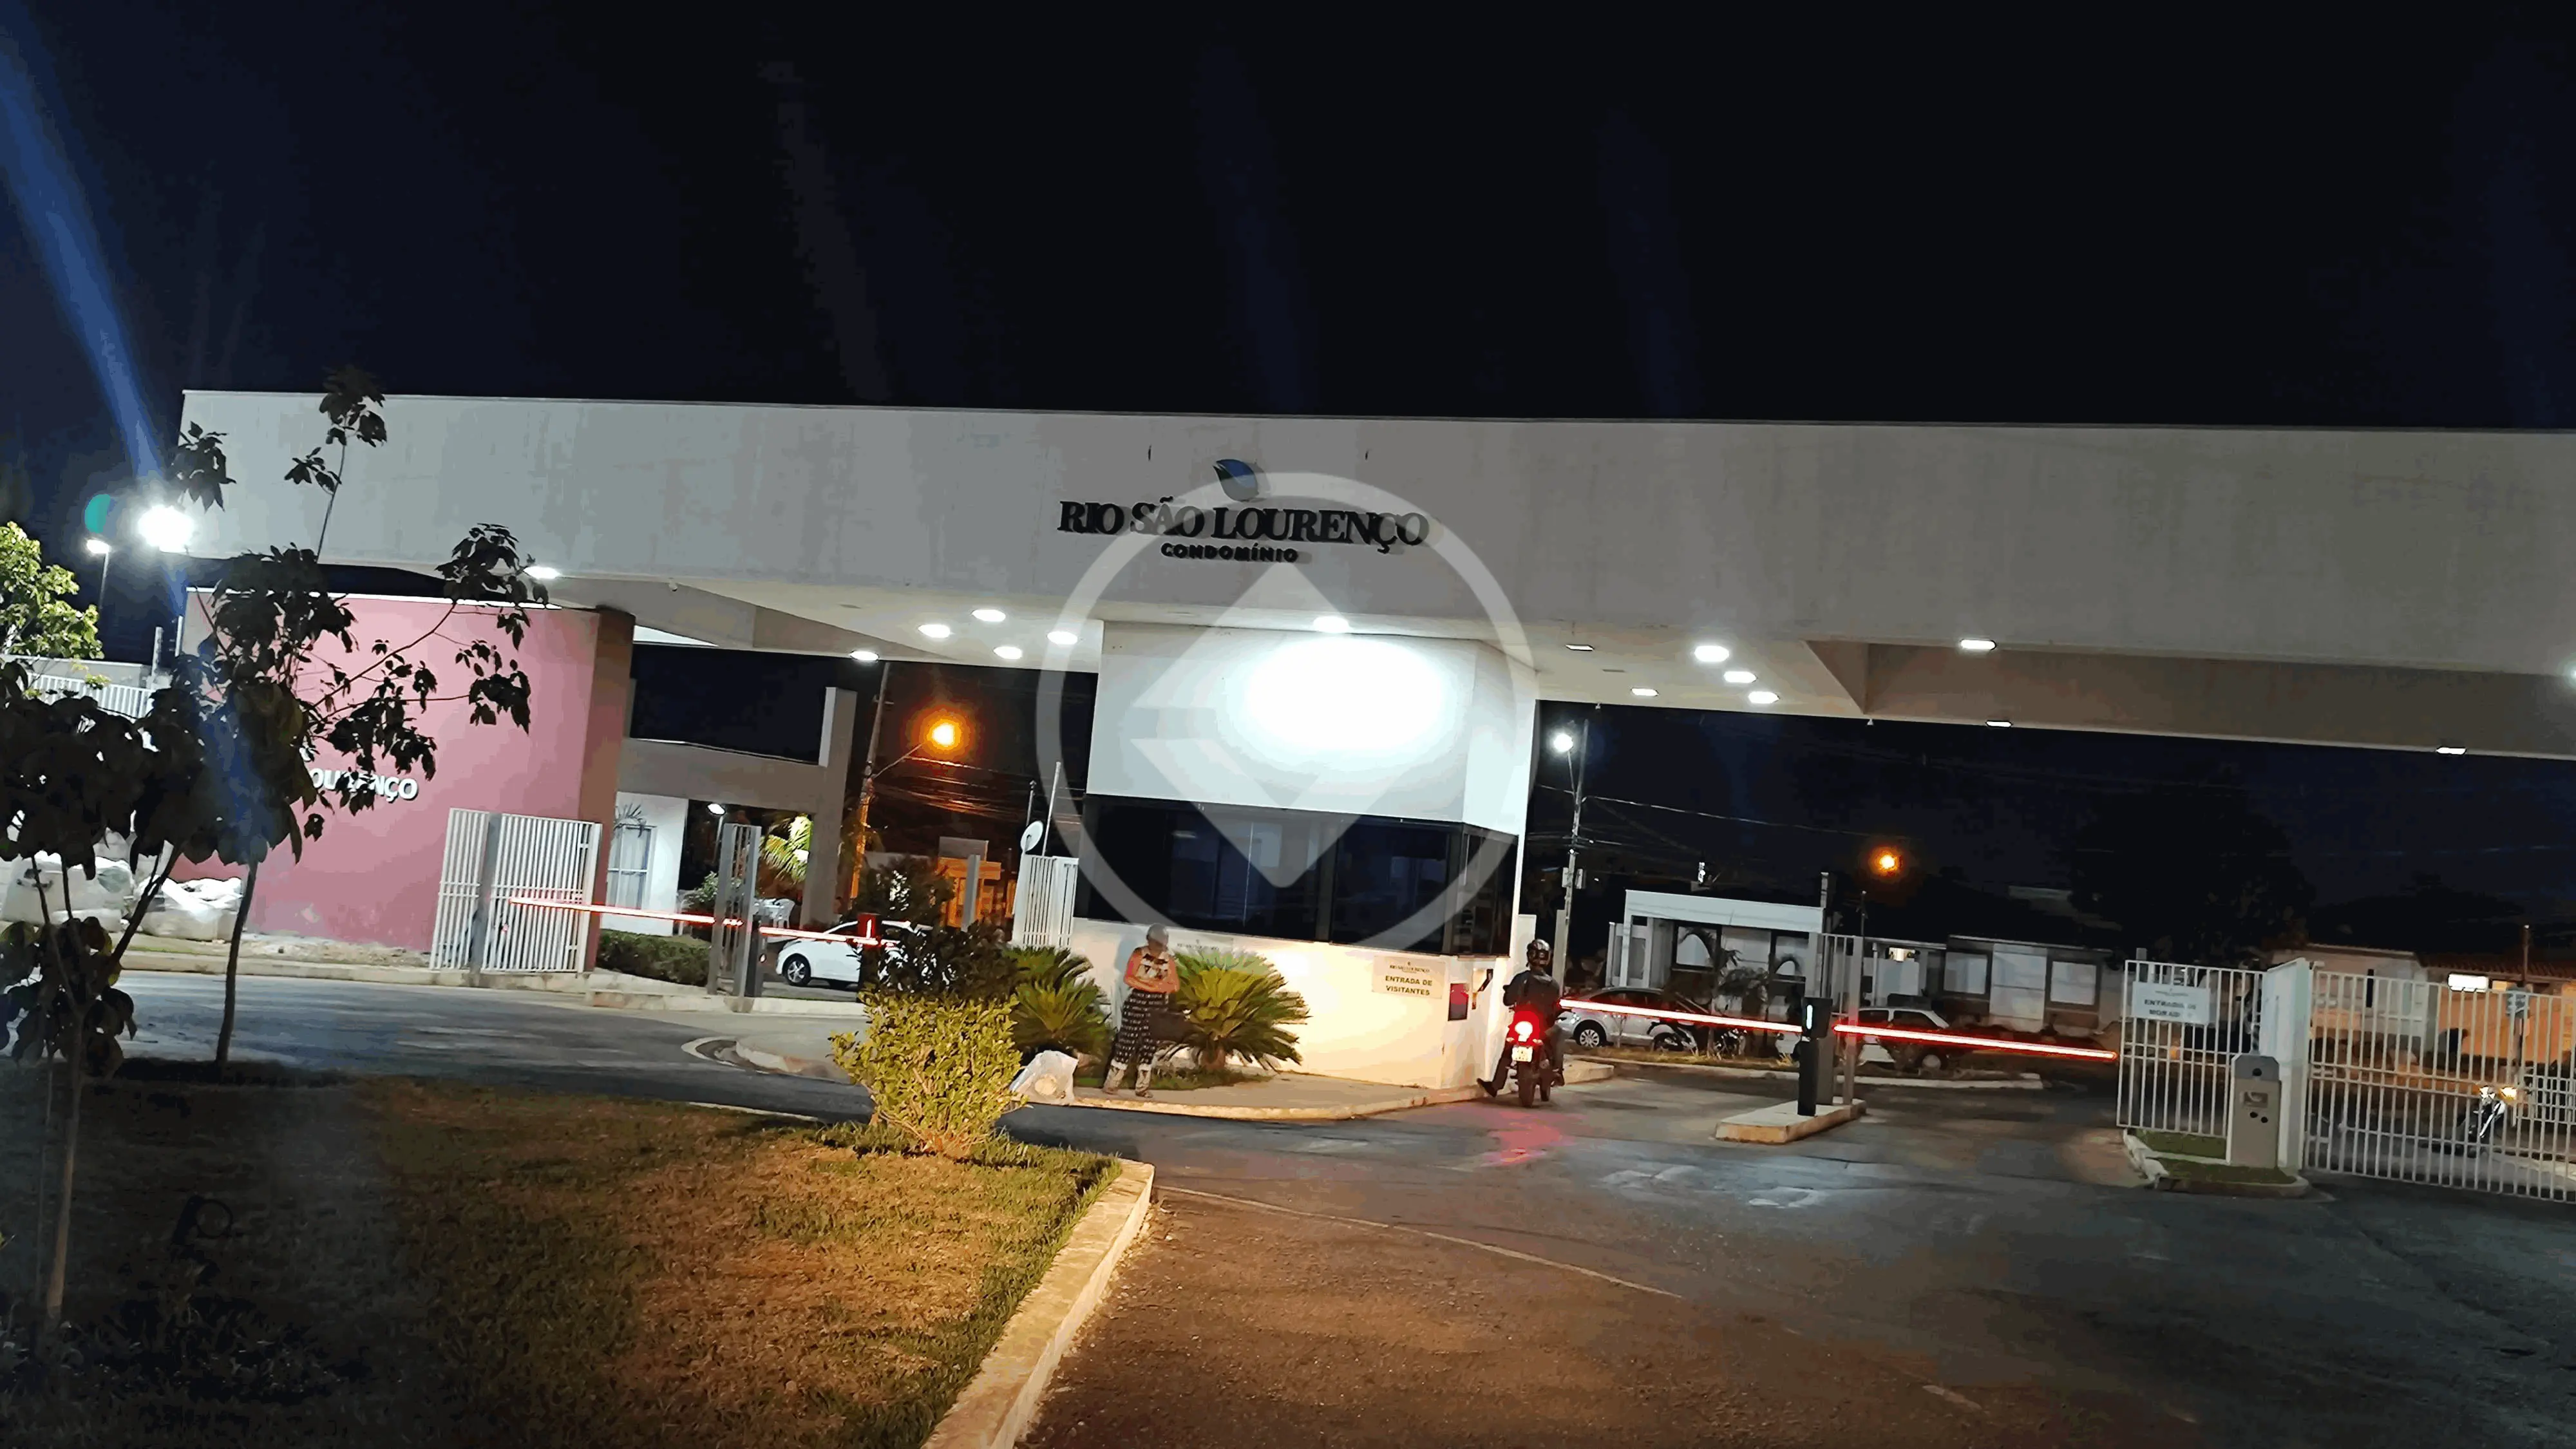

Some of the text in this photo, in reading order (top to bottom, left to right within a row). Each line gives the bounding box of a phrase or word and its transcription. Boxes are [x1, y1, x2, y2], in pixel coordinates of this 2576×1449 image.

[1057, 495, 1430, 554] RIO SÃO LOURENÇO
[1160, 542, 1298, 562] CONDOMÍNIO
[1385, 976, 1420, 984] ENTRADA
[1386, 985, 1430, 996] VISITANTES
